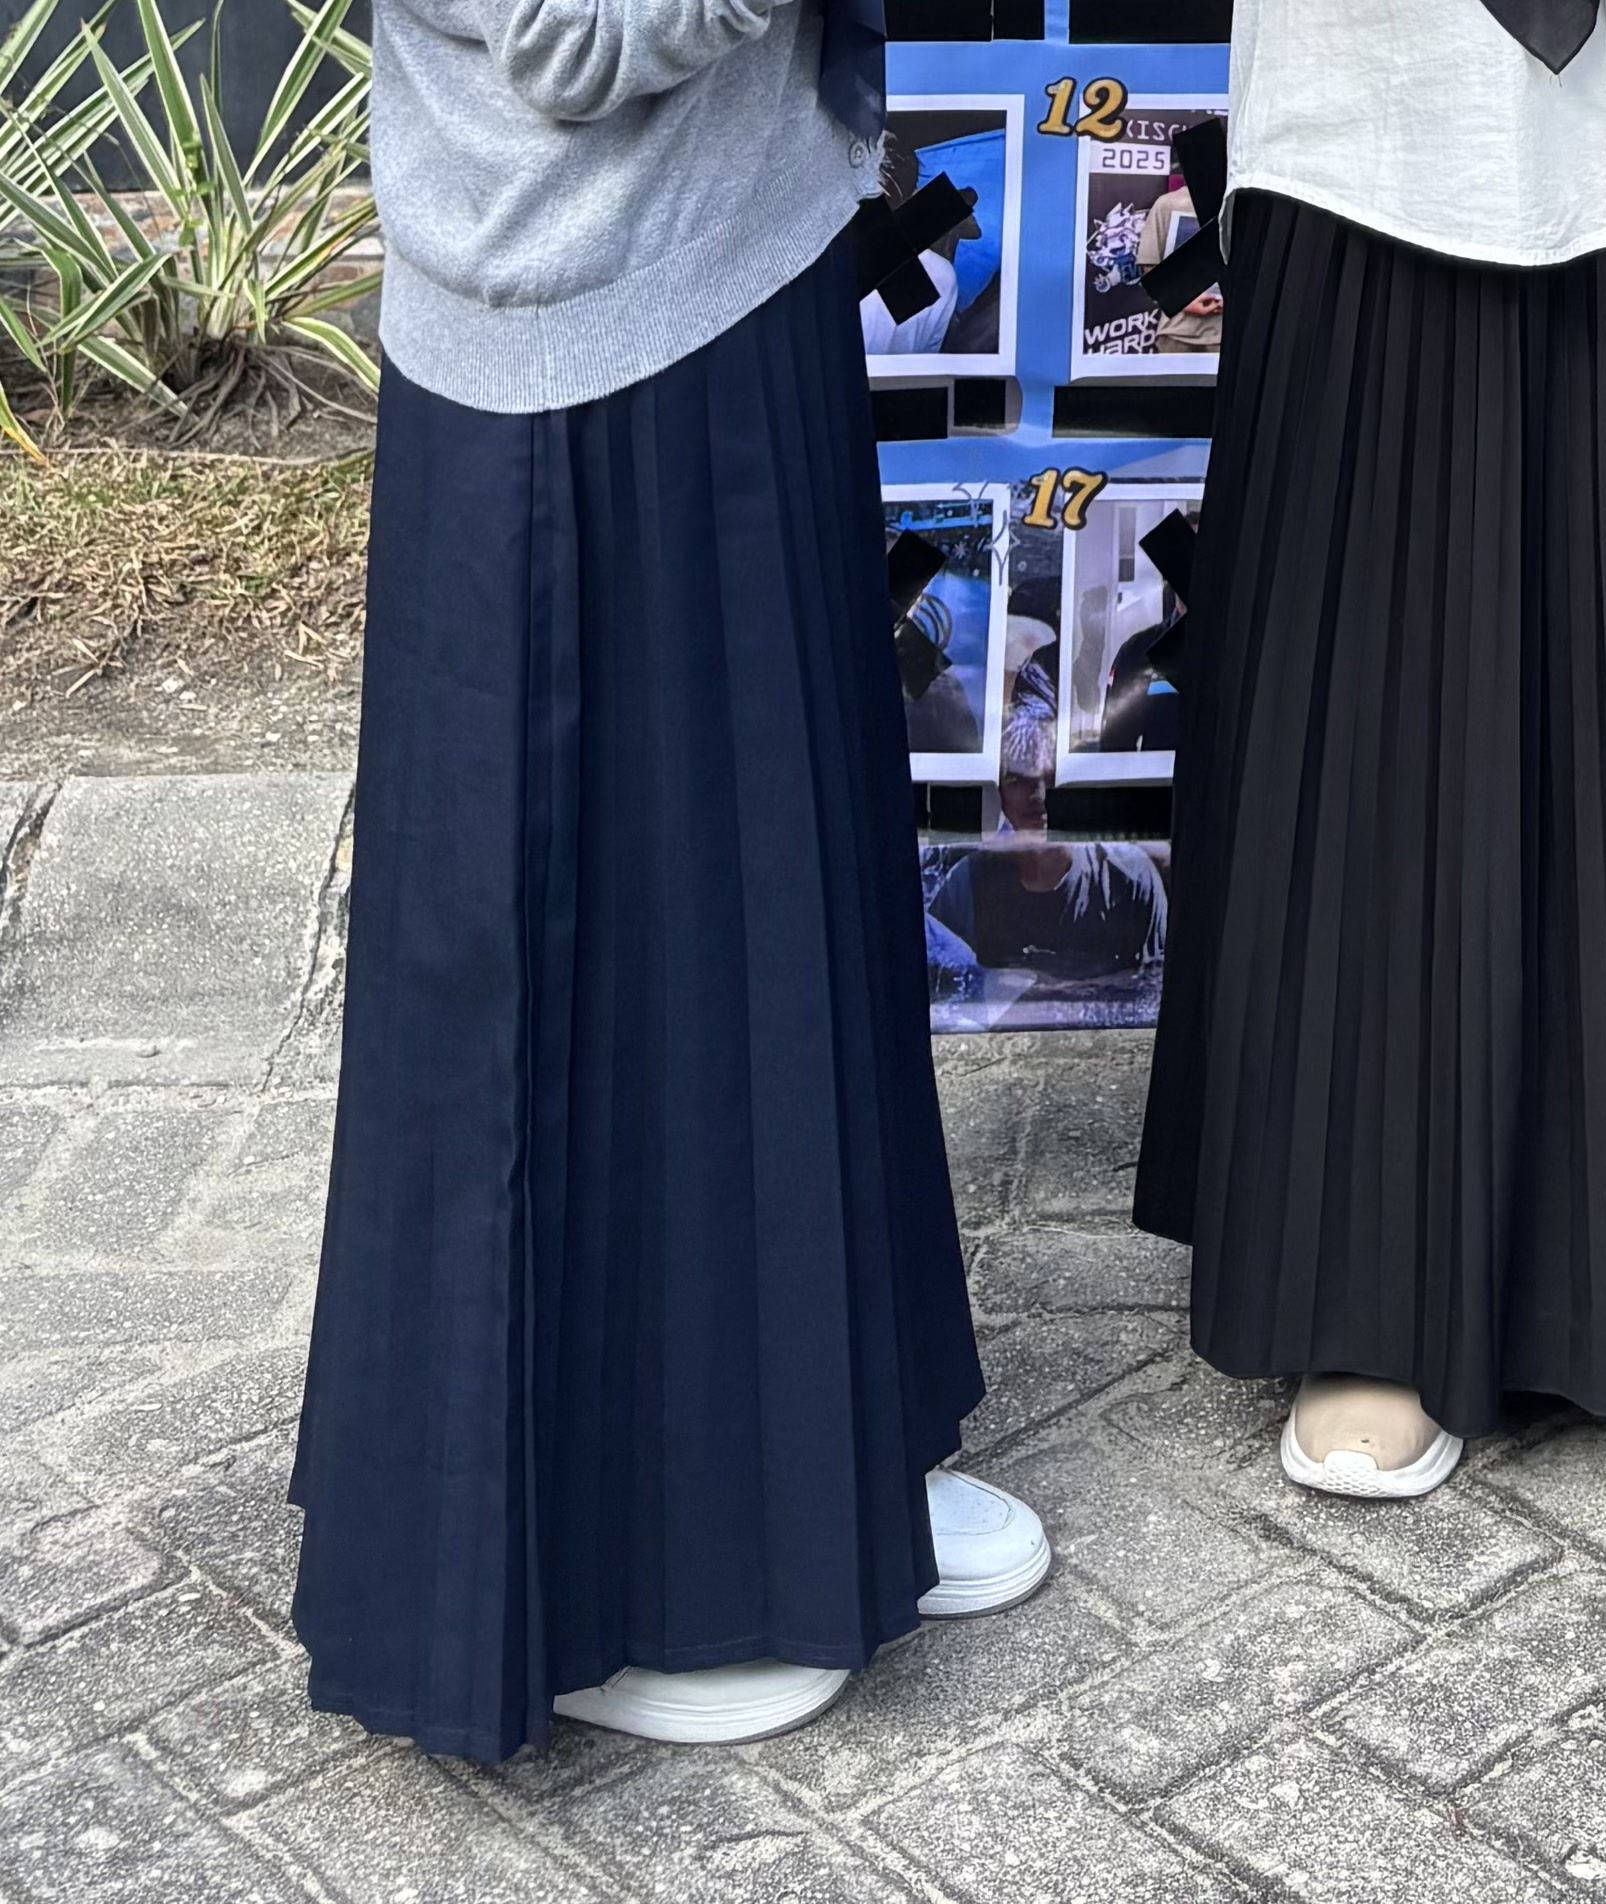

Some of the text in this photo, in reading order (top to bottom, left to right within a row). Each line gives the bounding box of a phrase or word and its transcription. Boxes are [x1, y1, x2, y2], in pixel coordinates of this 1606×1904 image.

[1037, 77, 1128, 141] 12
[1102, 148, 1166, 171] 2025
[1084, 308, 1159, 345] WORK
[1023, 467, 1108, 531] 17
